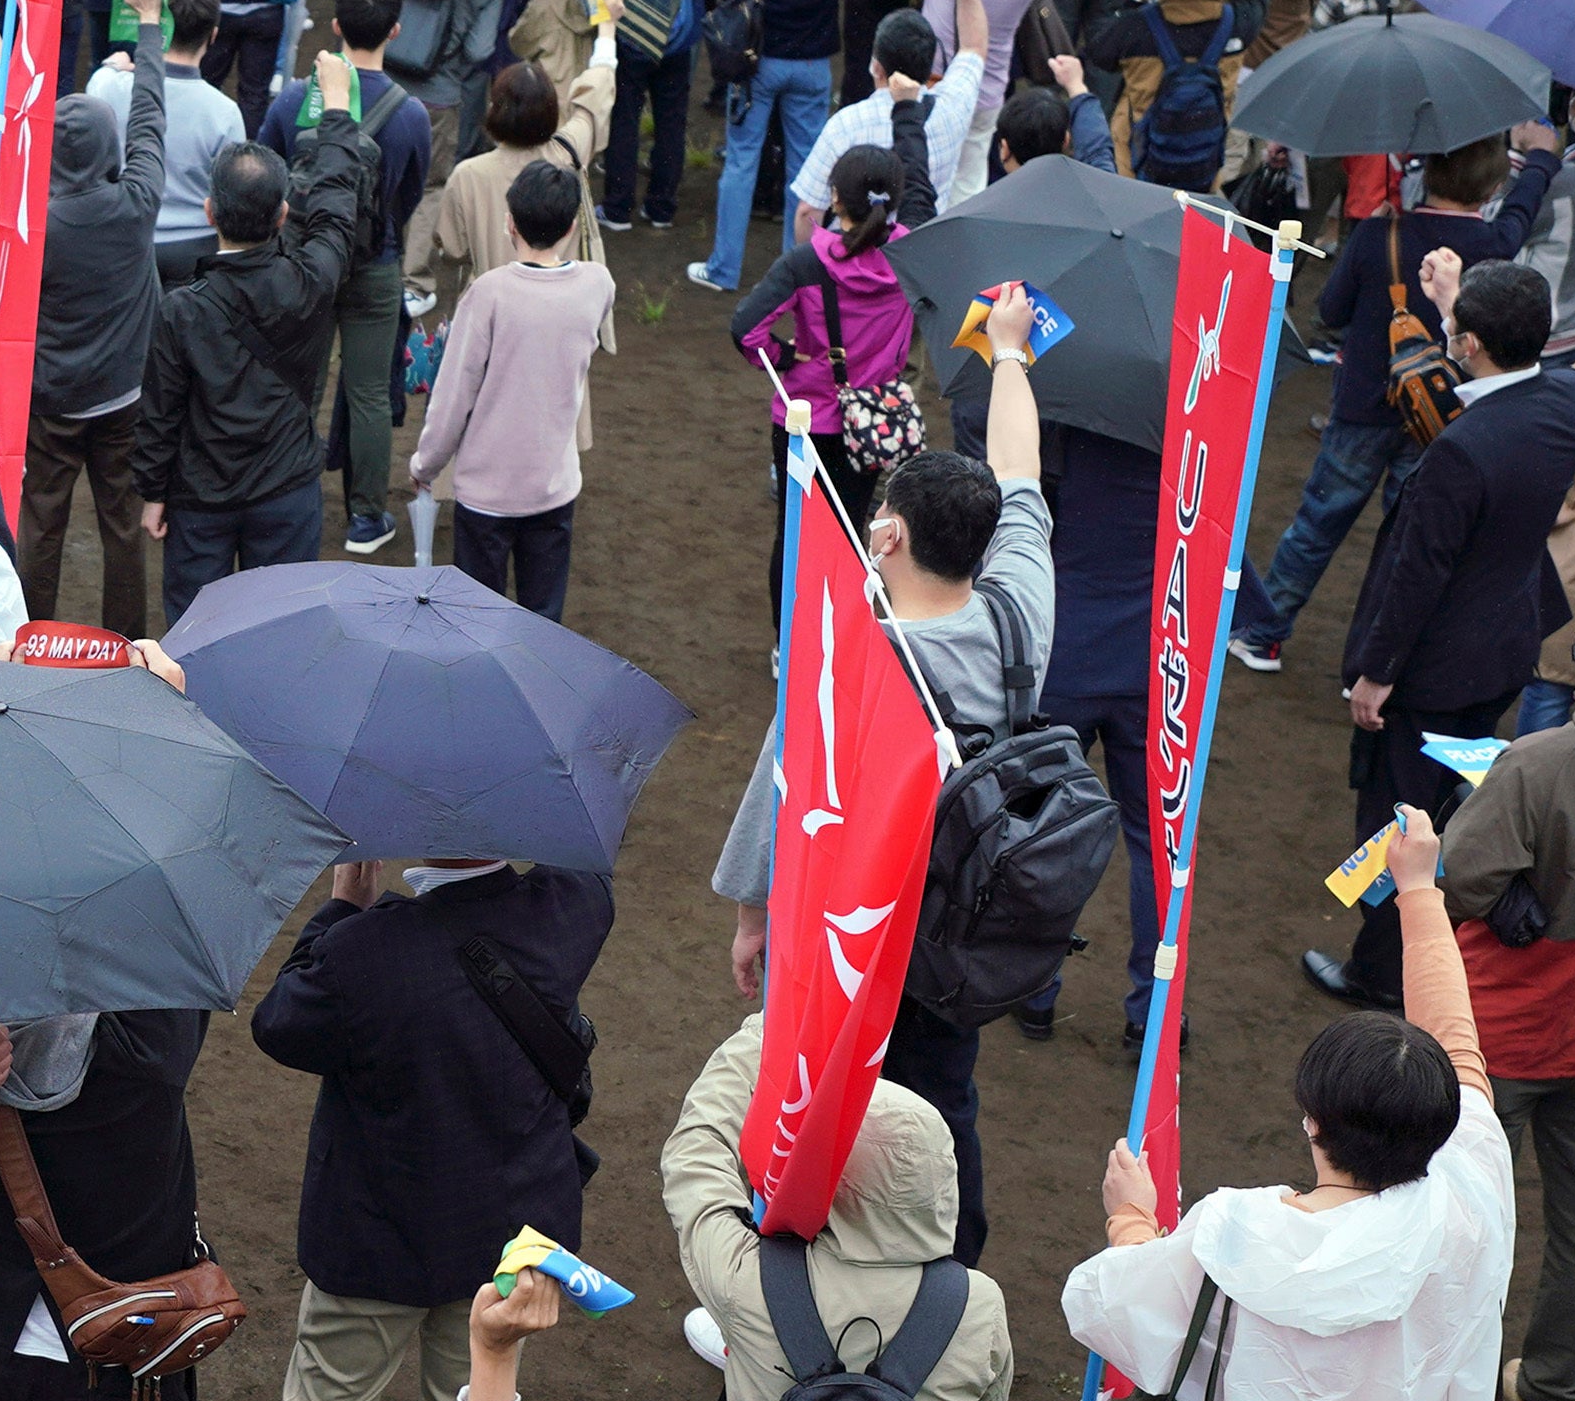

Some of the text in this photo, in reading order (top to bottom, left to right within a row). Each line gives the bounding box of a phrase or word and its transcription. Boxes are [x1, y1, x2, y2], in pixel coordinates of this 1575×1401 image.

[1025, 296, 1059, 338] ACE
[24, 634, 124, 662] 93 MAY DAY
[1339, 847, 1369, 878] NO
